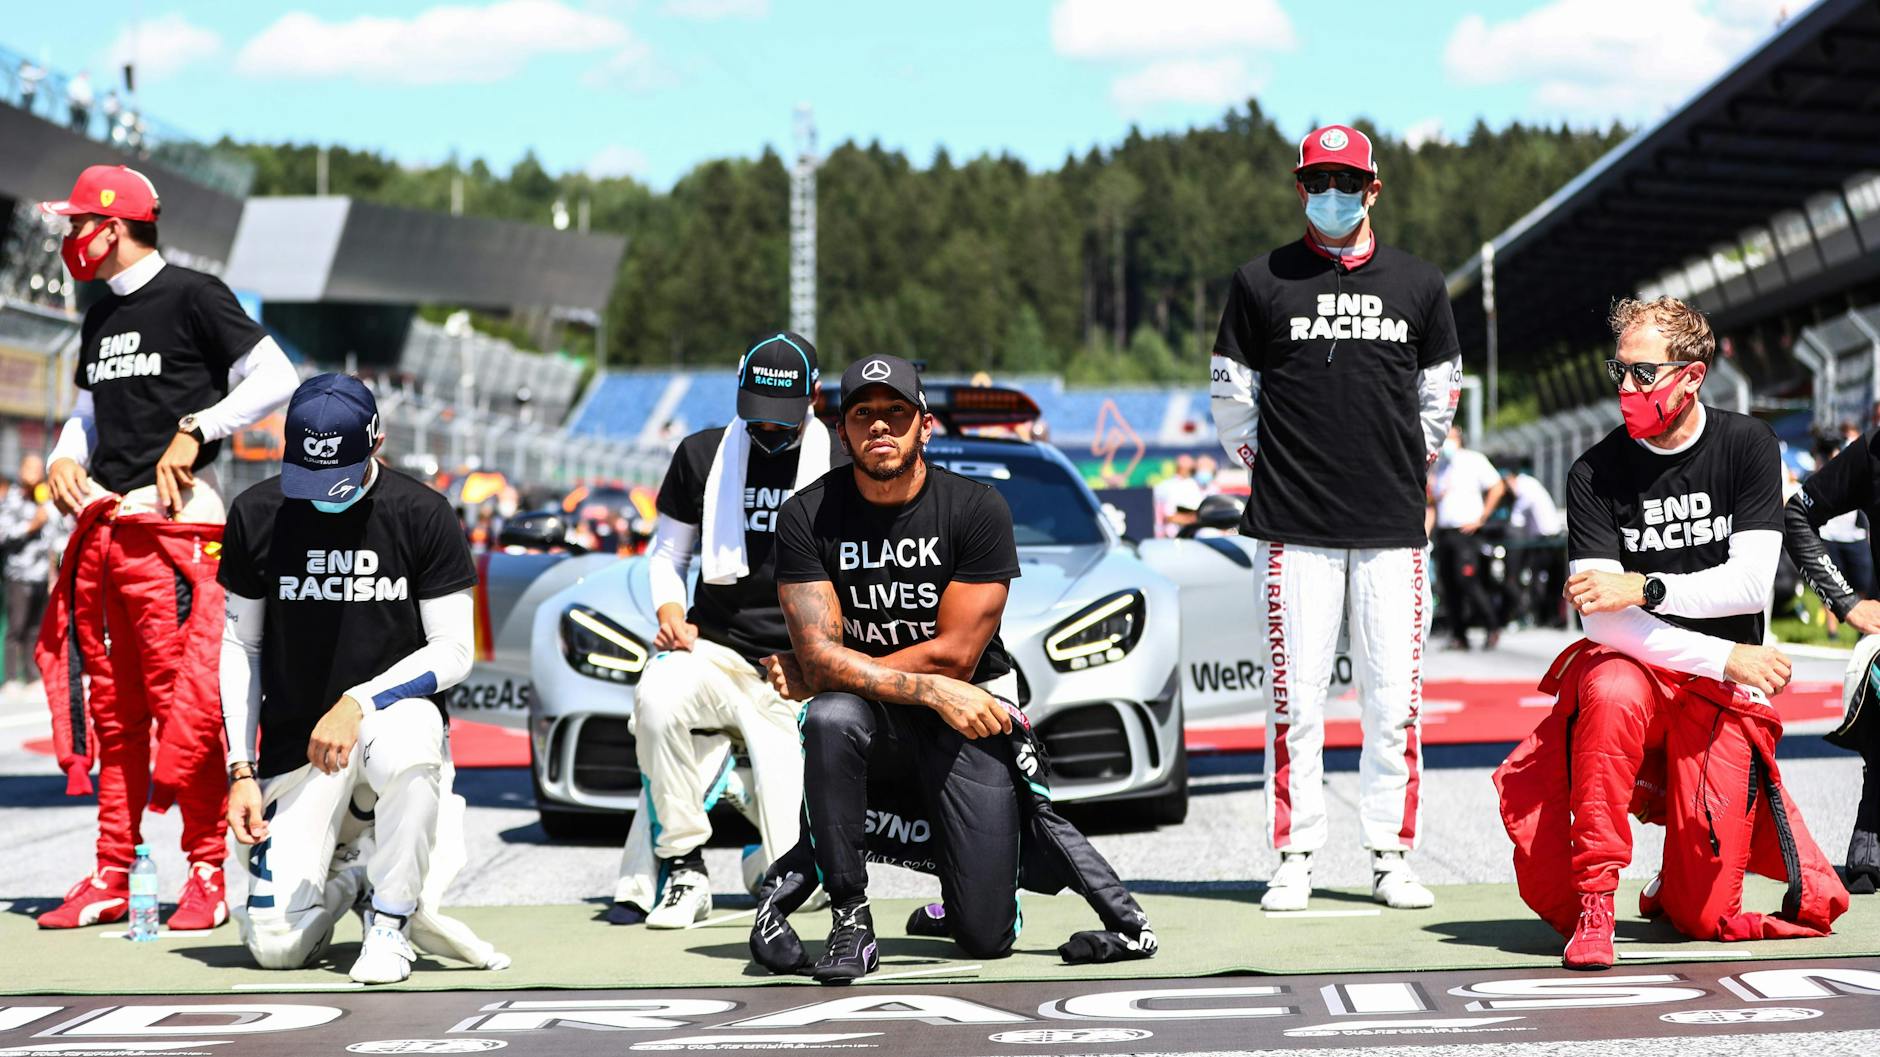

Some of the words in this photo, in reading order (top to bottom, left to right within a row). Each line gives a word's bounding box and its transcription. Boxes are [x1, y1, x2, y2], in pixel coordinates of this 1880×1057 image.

[1317, 293, 1383, 317] END
[1290, 316, 1408, 343] RACISM
[99, 331, 141, 359] END
[752, 366, 799, 379] WILLIAMS
[755, 376, 793, 387] RACING
[365, 413, 380, 448] 10
[1643, 492, 1712, 525] END
[307, 550, 379, 575] END
[839, 537, 942, 571] BLACK
[279, 576, 408, 602] RACISM
[850, 582, 938, 610] LIVES
[842, 616, 937, 646] MATTE
